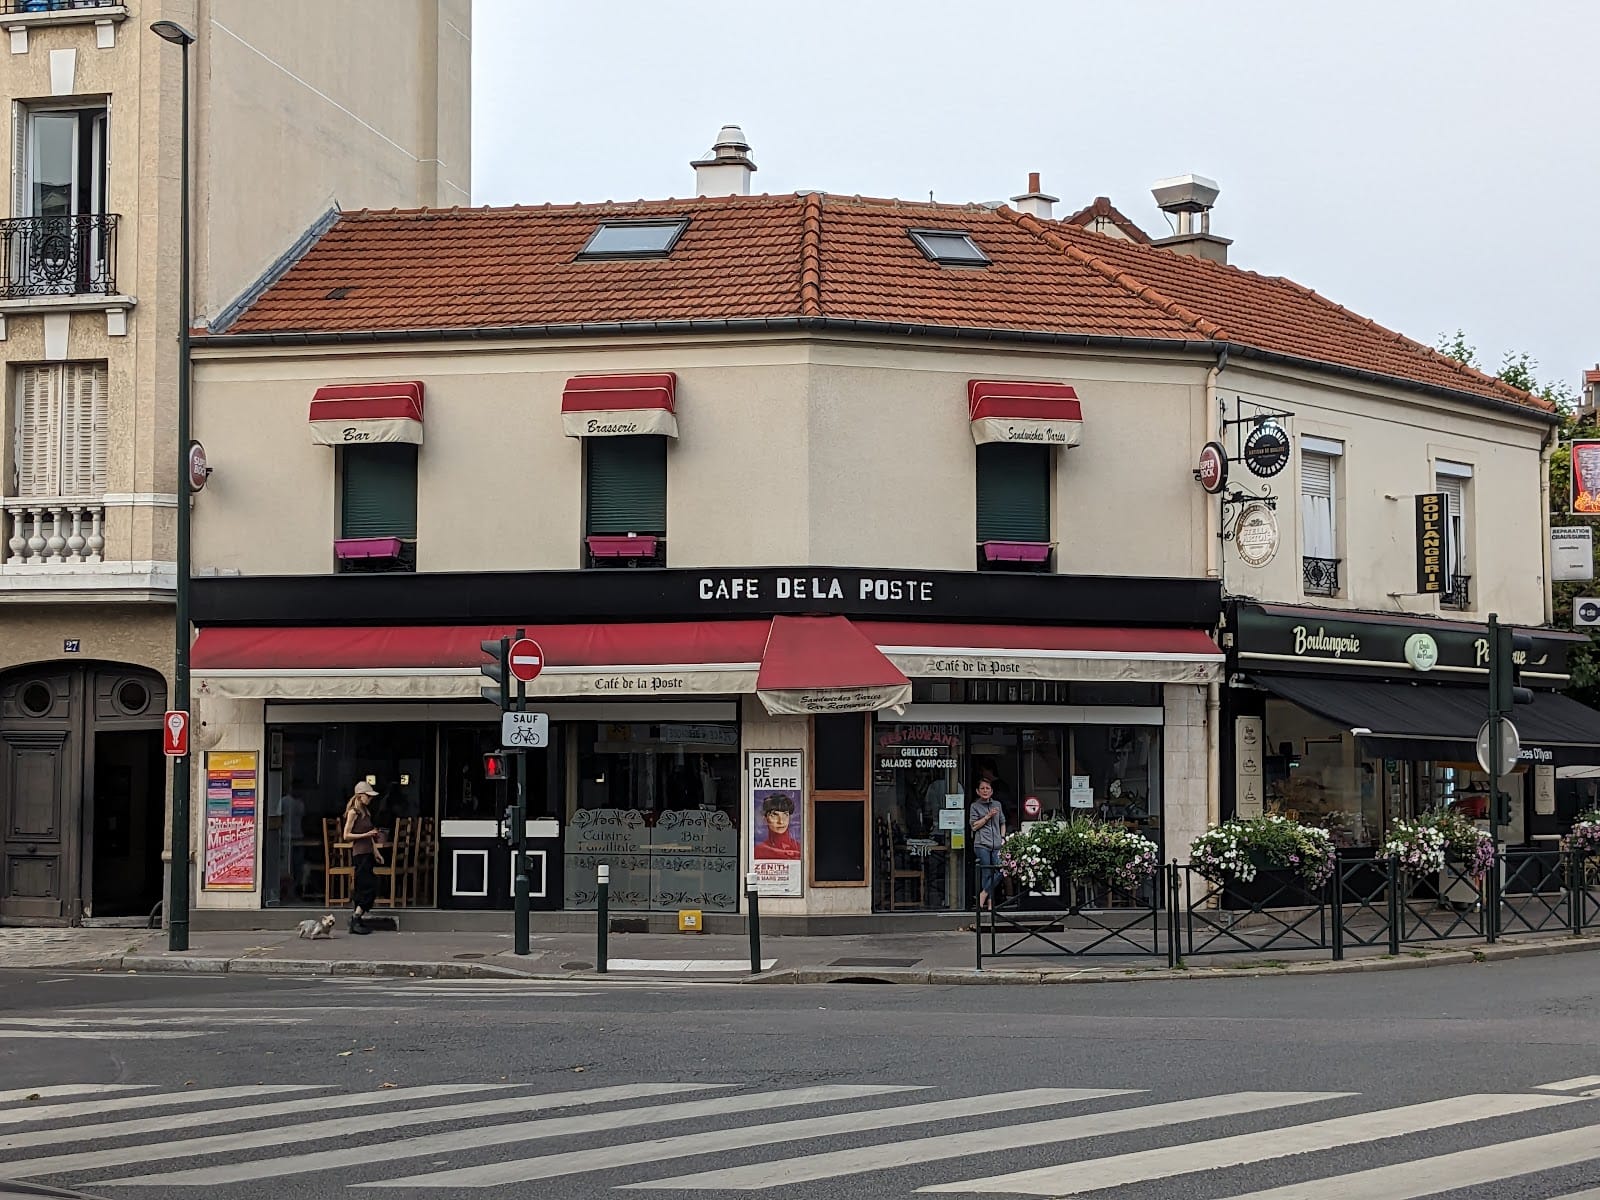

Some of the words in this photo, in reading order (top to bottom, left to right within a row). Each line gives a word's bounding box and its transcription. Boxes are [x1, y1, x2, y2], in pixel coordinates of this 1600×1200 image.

[587, 419, 637, 433] Brasserie
[342, 427, 370, 441] Bar
[1008, 426, 1044, 441] Sandwiches
[1423, 495, 1440, 591] BOULANGERIE
[699, 578, 759, 600] CAFE
[859, 578, 934, 601] POSTE
[65, 640, 79, 651] 27
[1292, 625, 1361, 659] Boulangerie
[936, 660, 960, 671] Café
[962, 660, 974, 672] de
[977, 661, 986, 672] la
[989, 660, 1020, 675] Poste
[594, 677, 620, 690] Café
[622, 676, 634, 689] de
[637, 677, 647, 689] la
[650, 676, 683, 691] Poste
[513, 714, 539, 723] SAUF
[901, 748, 938, 757] GRILLADES
[753, 757, 798, 767] PIERRE
[881, 759, 912, 768] SALADES
[753, 768, 770, 778] DE
[753, 778, 797, 788] MAERE
[208, 829, 237, 850] Music
